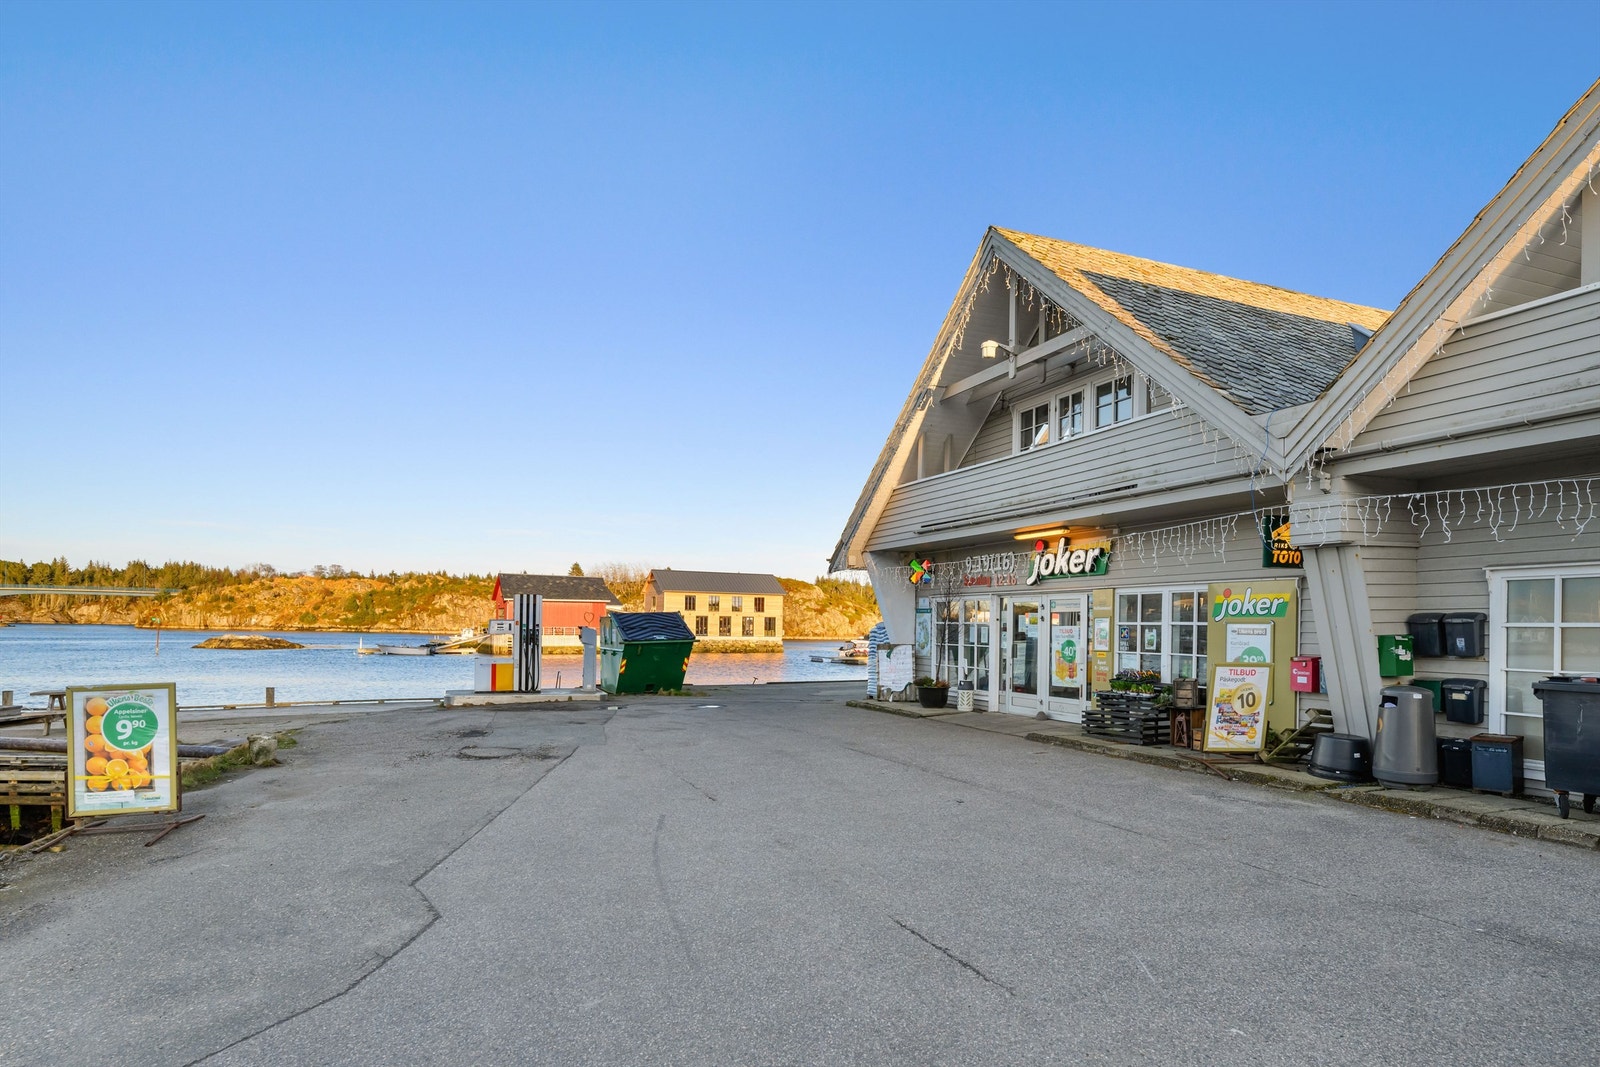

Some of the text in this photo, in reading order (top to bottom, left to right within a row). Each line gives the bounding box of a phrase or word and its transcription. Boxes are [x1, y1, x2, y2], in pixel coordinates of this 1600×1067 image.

[1026, 537, 1101, 585] joker
[1272, 550, 1301, 564] TOTO
[1214, 587, 1284, 622] joker
[1229, 668, 1256, 676] TILBUD
[1237, 692, 1256, 709] 10
